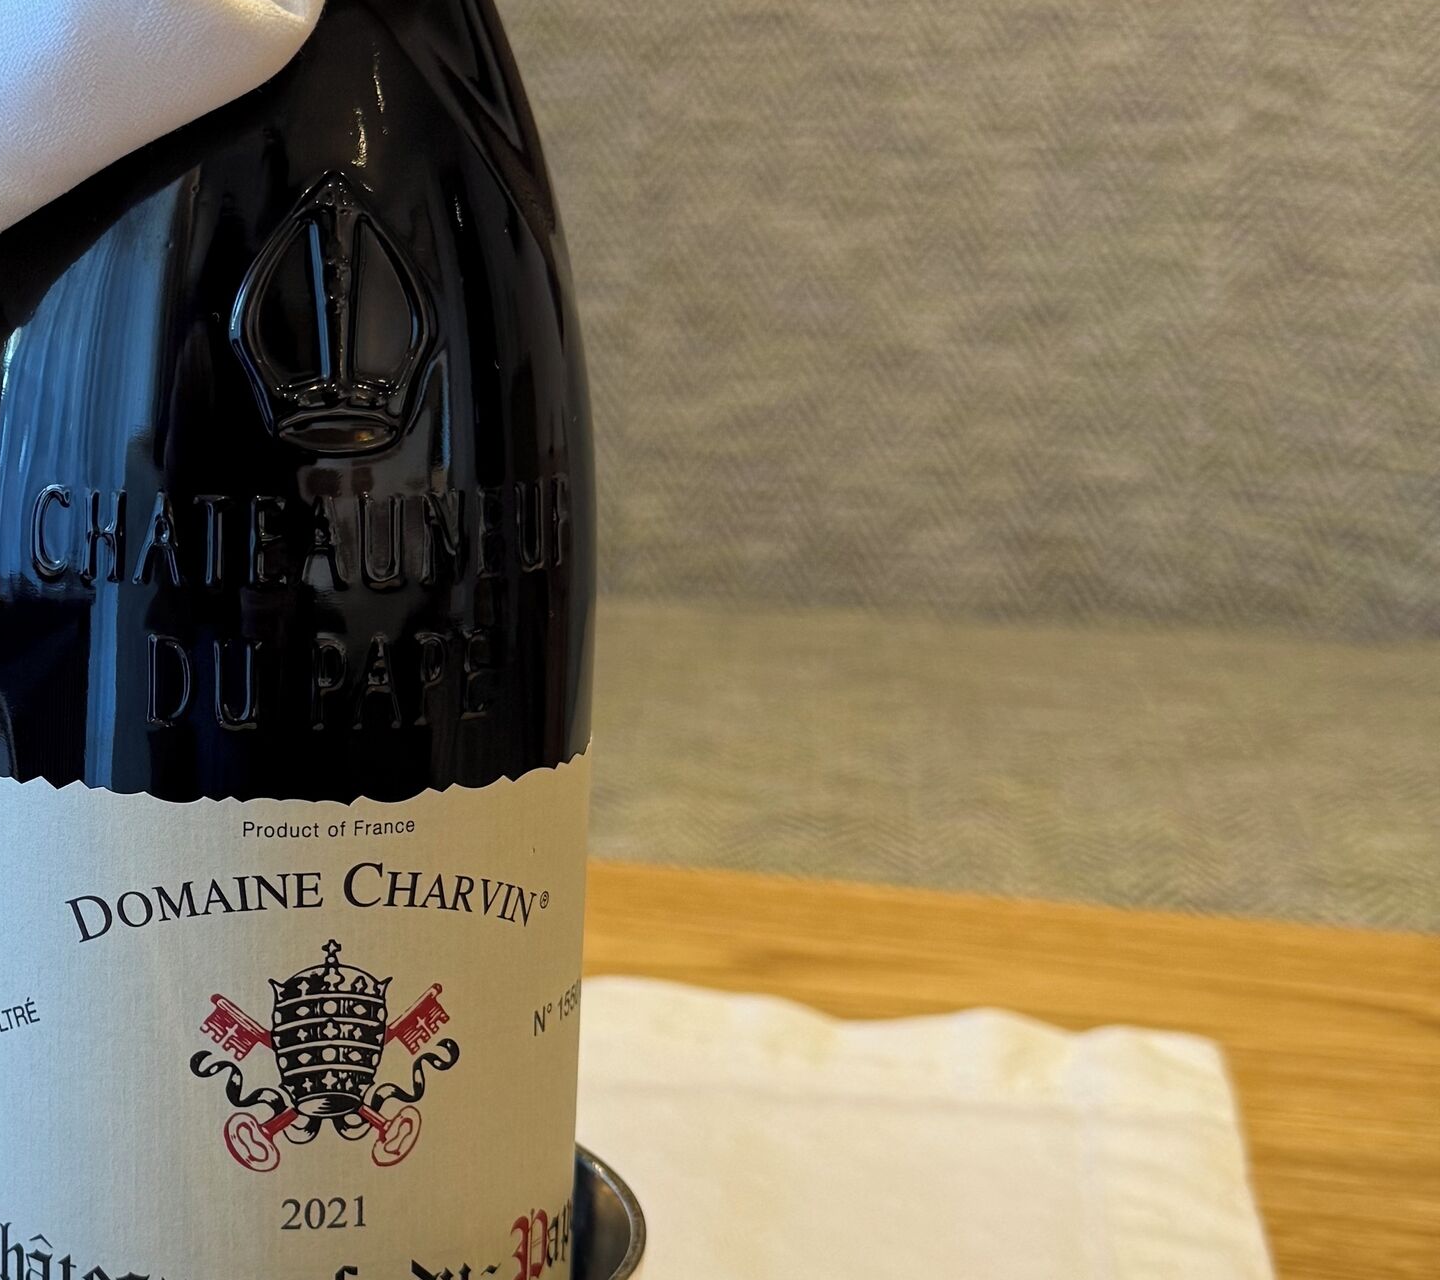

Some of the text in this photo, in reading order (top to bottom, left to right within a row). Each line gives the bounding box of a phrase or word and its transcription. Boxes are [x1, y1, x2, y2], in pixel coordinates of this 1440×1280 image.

[146, 628, 490, 730] DU PAPE
[242, 818, 415, 839] Product of France
[66, 871, 324, 943] DOMAINE
[280, 1195, 367, 1231] 2021
